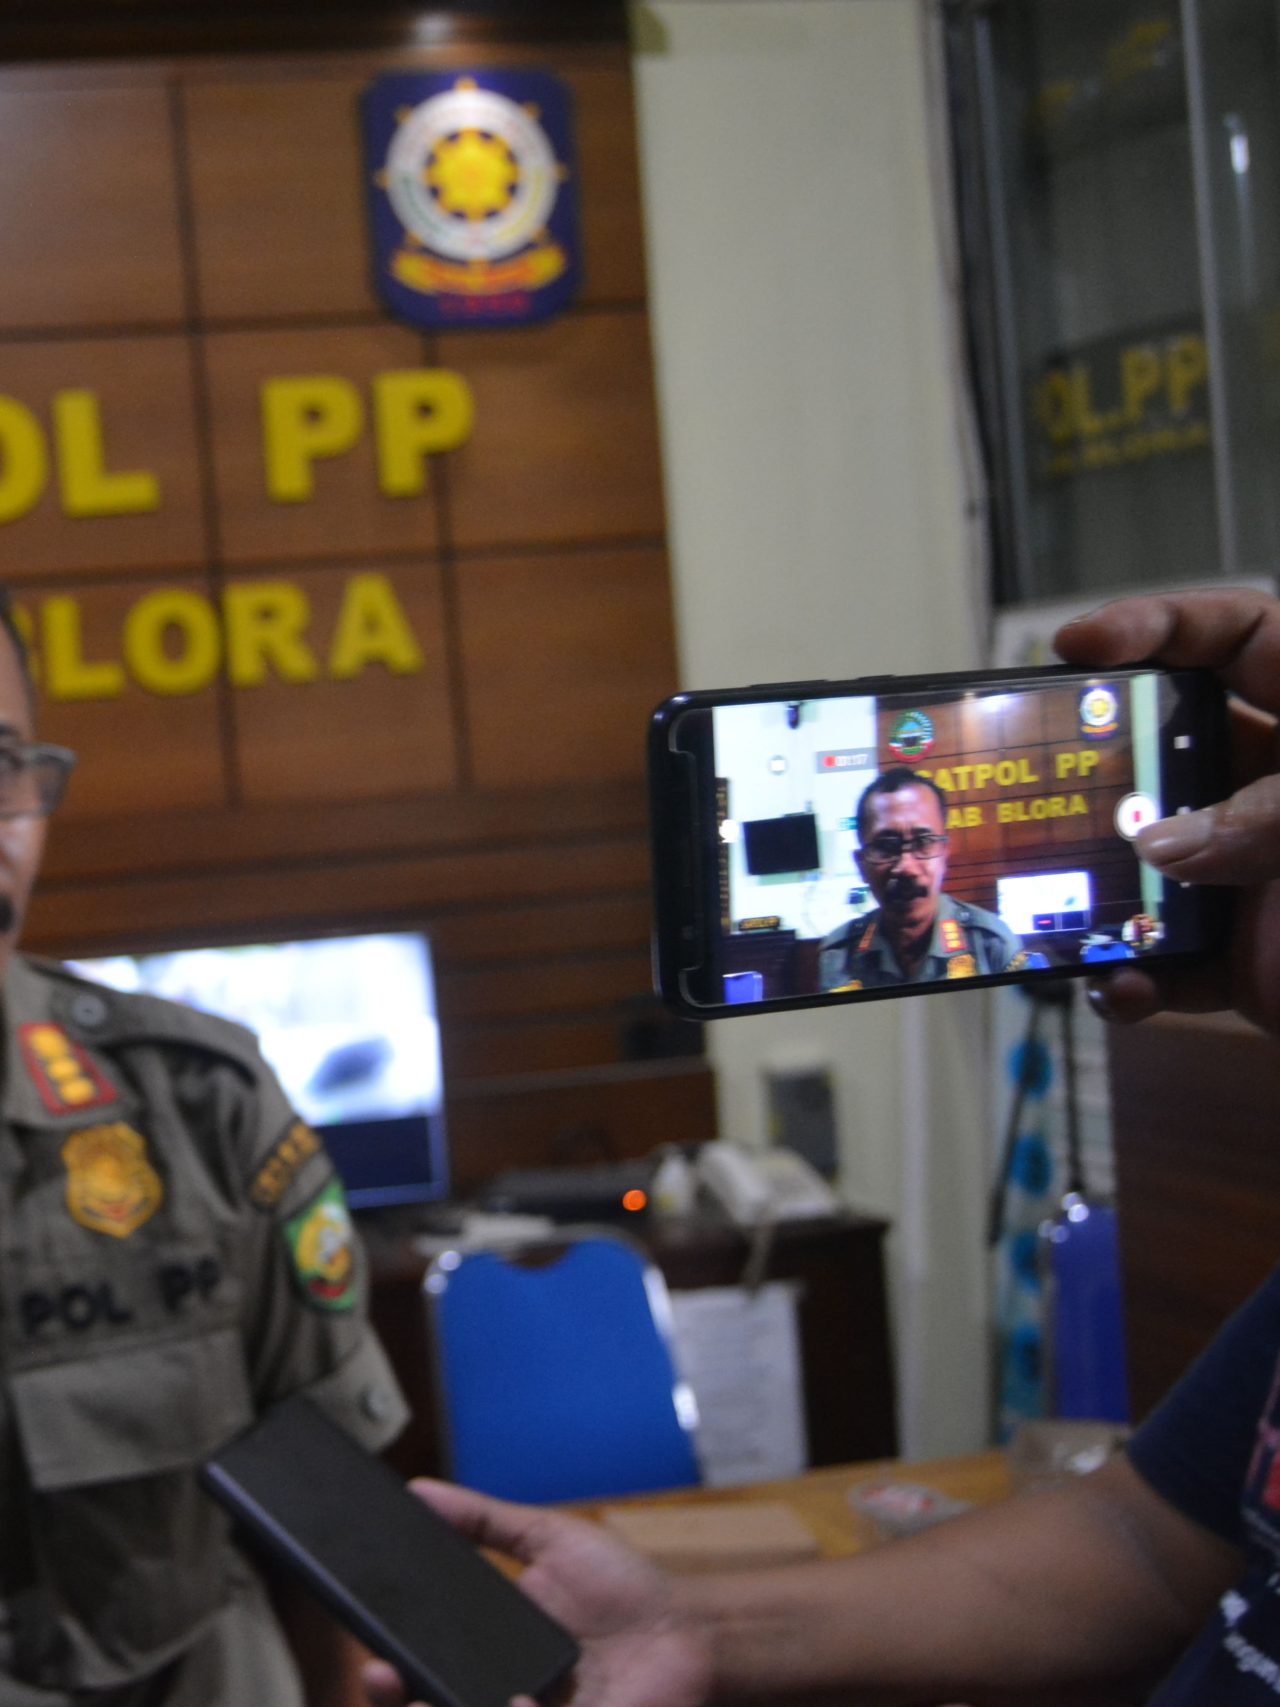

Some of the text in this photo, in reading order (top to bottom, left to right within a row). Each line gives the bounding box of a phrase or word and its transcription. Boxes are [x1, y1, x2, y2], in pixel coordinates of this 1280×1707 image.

[260, 368, 475, 504] PP
[12, 571, 425, 700] LORA
[1055, 749, 1100, 780] PP
[944, 794, 1089, 829] AB BLORA
[21, 1254, 222, 1338] POL PP
